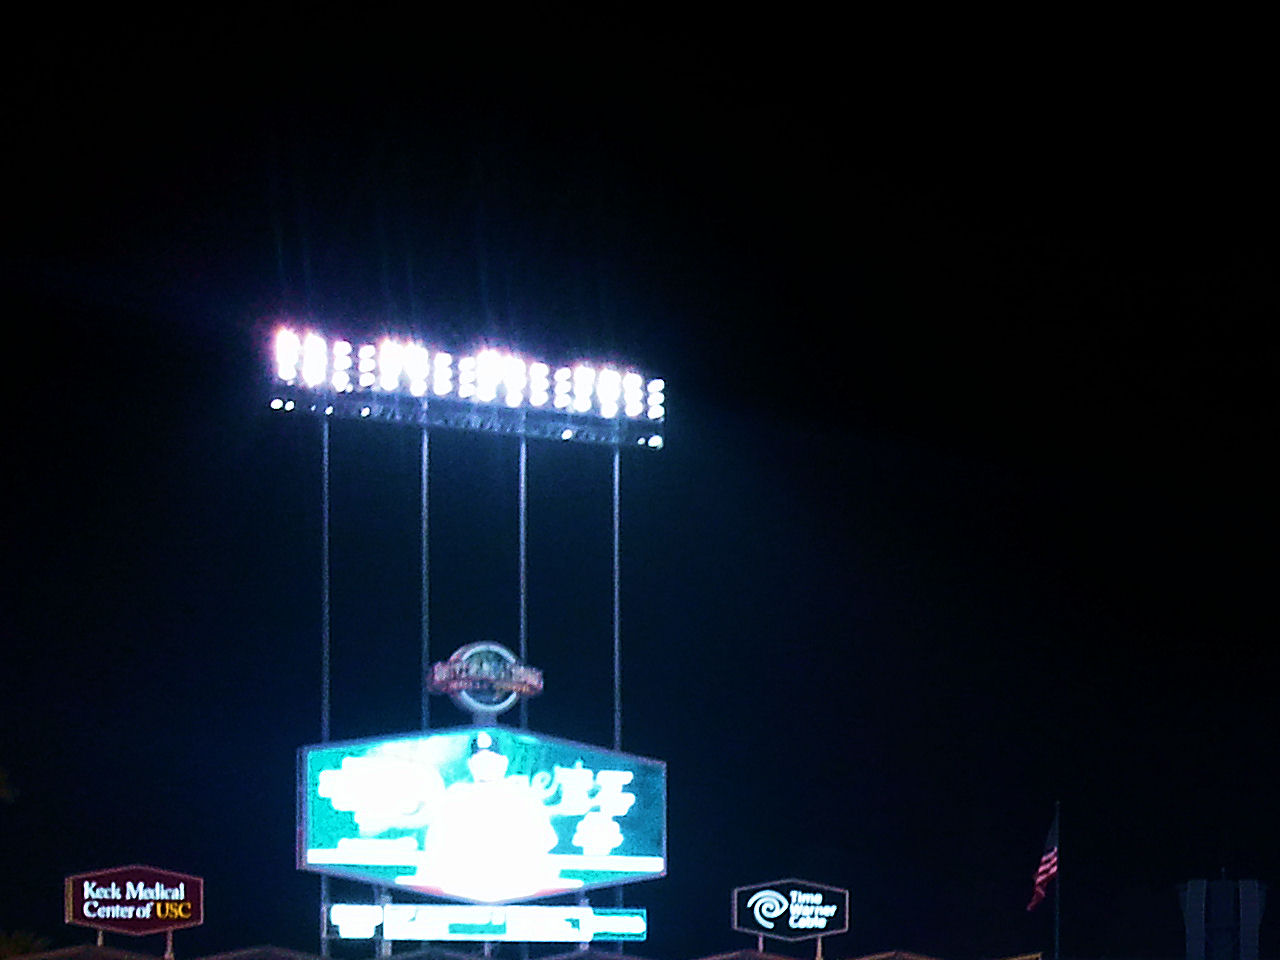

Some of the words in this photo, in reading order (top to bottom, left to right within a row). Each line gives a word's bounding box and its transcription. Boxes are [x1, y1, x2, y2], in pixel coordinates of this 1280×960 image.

[83, 880, 122, 900] Keck
[125, 881, 185, 901] Medical
[789, 890, 823, 905] Time
[83, 900, 136, 918] Center
[135, 901, 154, 918] of
[156, 901, 192, 918] USC
[789, 904, 838, 917] Warner
[789, 916, 828, 929] Cable
